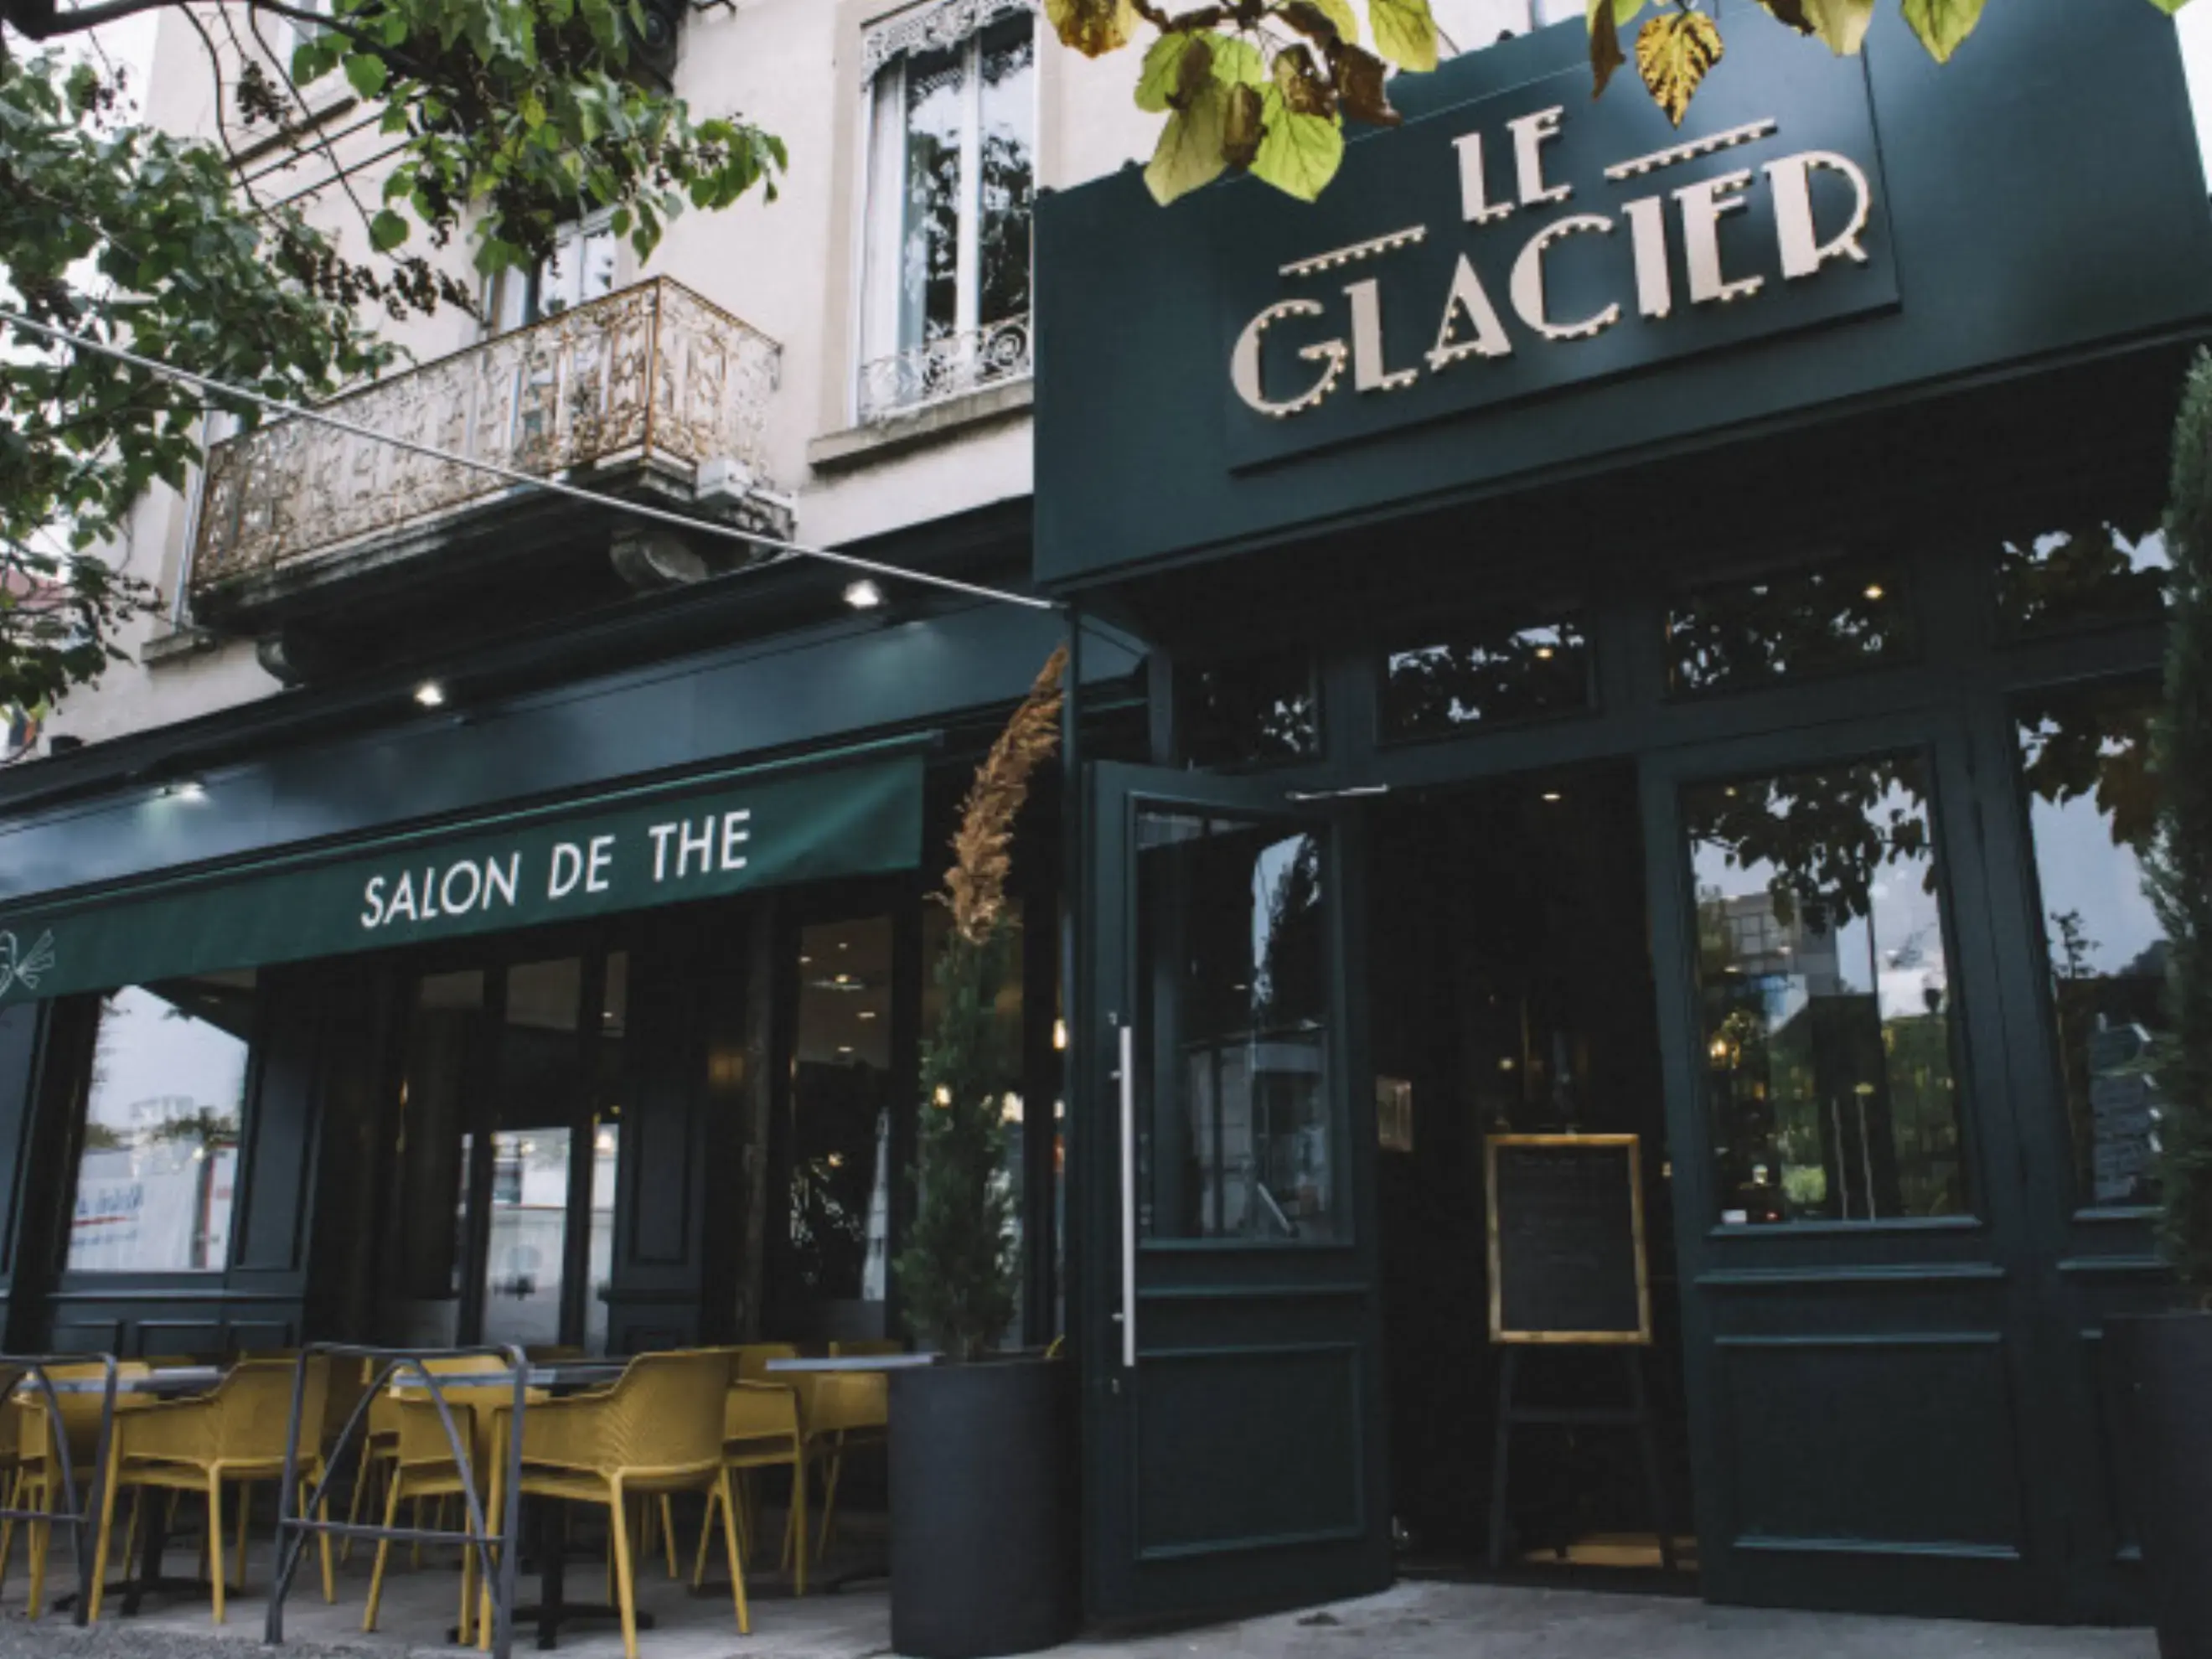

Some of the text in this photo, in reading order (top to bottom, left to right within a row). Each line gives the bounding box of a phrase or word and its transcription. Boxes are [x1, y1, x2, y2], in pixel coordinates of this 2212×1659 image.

[1452, 106, 1574, 225] LE
[1230, 150, 1871, 416] GLACIER
[361, 809, 751, 928] SALON DE THE
